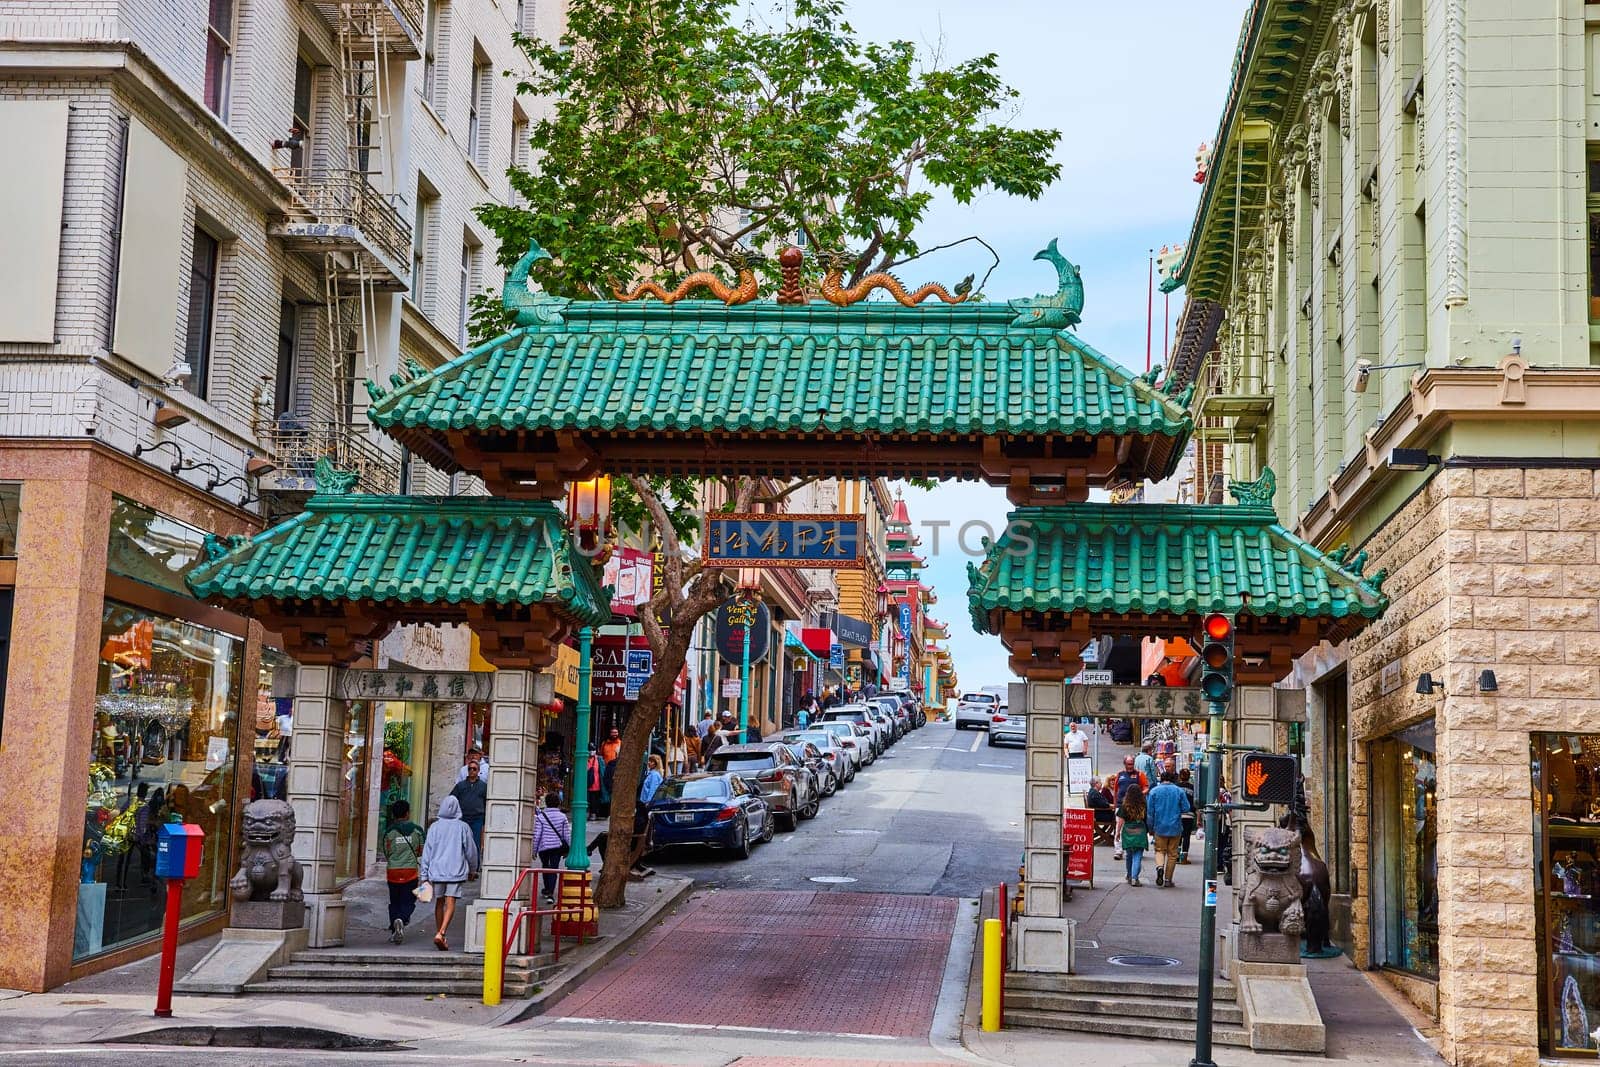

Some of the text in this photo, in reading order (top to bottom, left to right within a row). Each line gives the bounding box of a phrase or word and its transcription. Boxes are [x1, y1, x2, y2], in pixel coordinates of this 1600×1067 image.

[902, 607, 910, 635] CITY
[1073, 834, 1086, 843] TO
[1072, 843, 1091, 853] OFF
